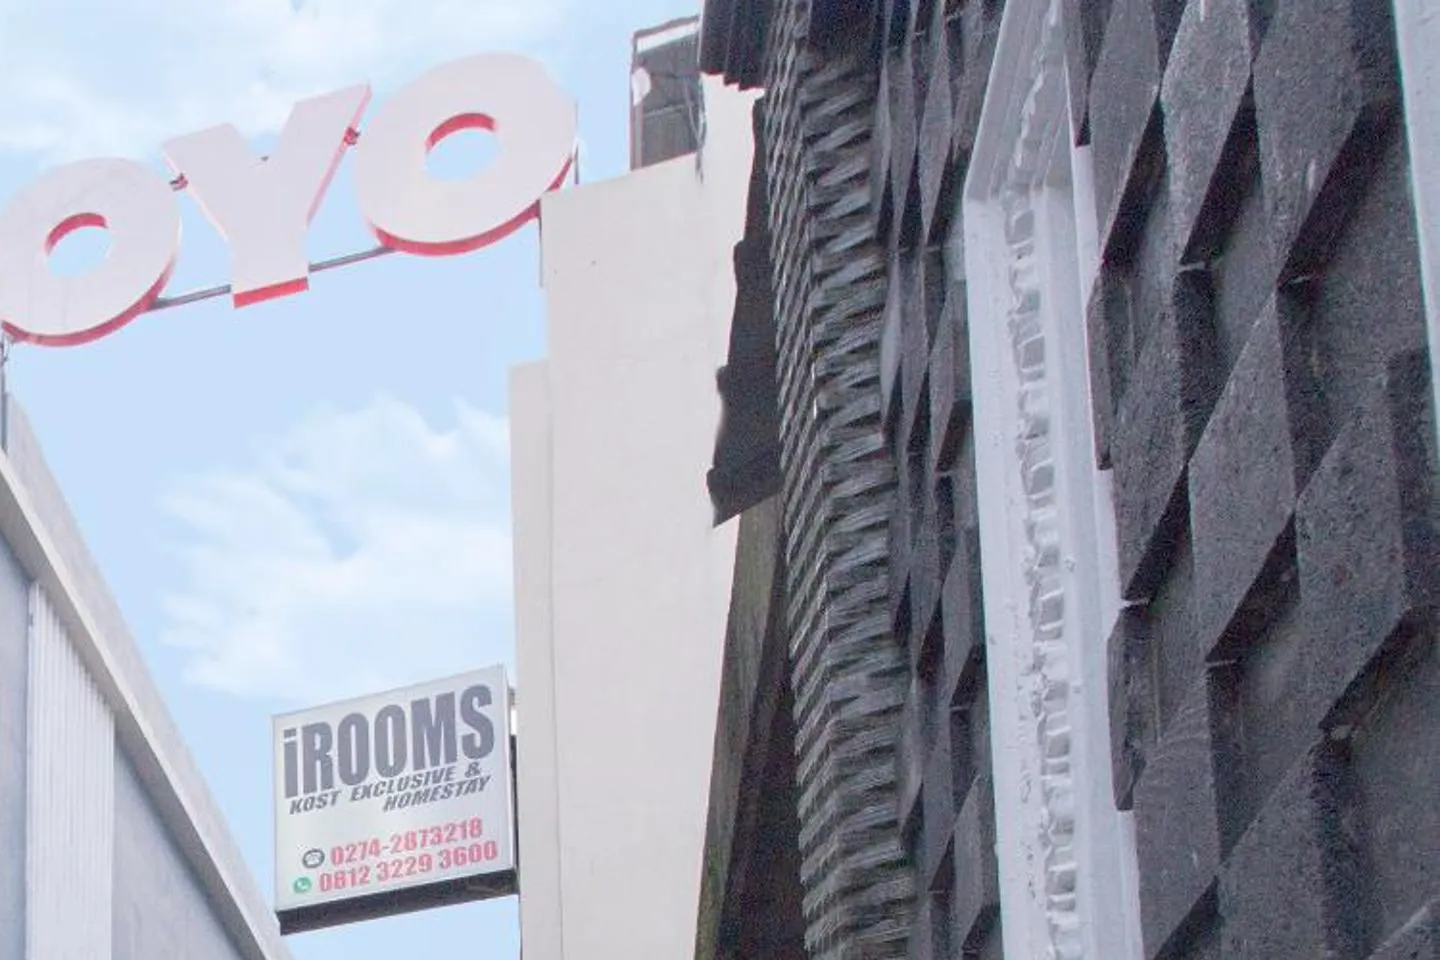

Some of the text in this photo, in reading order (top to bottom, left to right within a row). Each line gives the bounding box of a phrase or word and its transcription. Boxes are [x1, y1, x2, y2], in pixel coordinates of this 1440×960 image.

[283, 684, 495, 799] iROOMS
[289, 761, 481, 815] KOST EXCLUSIVE &
[382, 775, 492, 812] HOMESTAY
[319, 839, 498, 892] 0812 3229 3600
[330, 816, 483, 866] 0274-2873218
